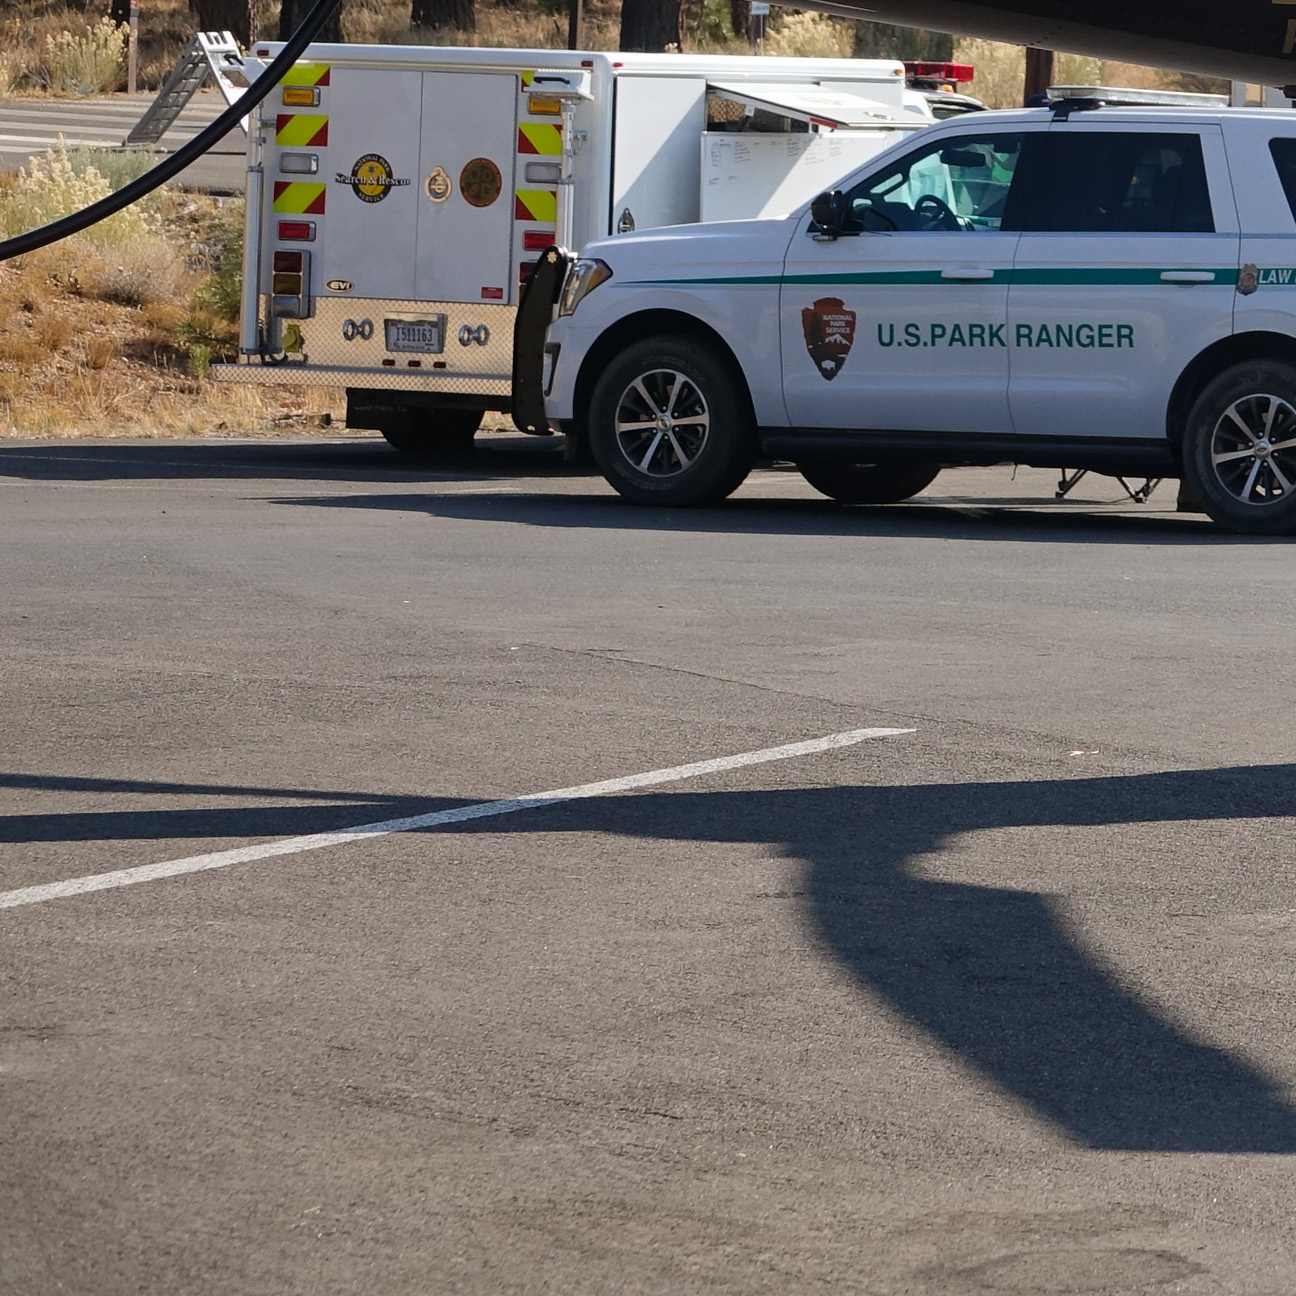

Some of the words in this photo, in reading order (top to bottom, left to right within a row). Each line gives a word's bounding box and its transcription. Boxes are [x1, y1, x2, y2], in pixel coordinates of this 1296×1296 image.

[334, 172, 366, 185] Search
[1258, 269, 1293, 284] LAW
[825, 326, 851, 334] SERVICE
[1016, 323, 1135, 349] RANGER
